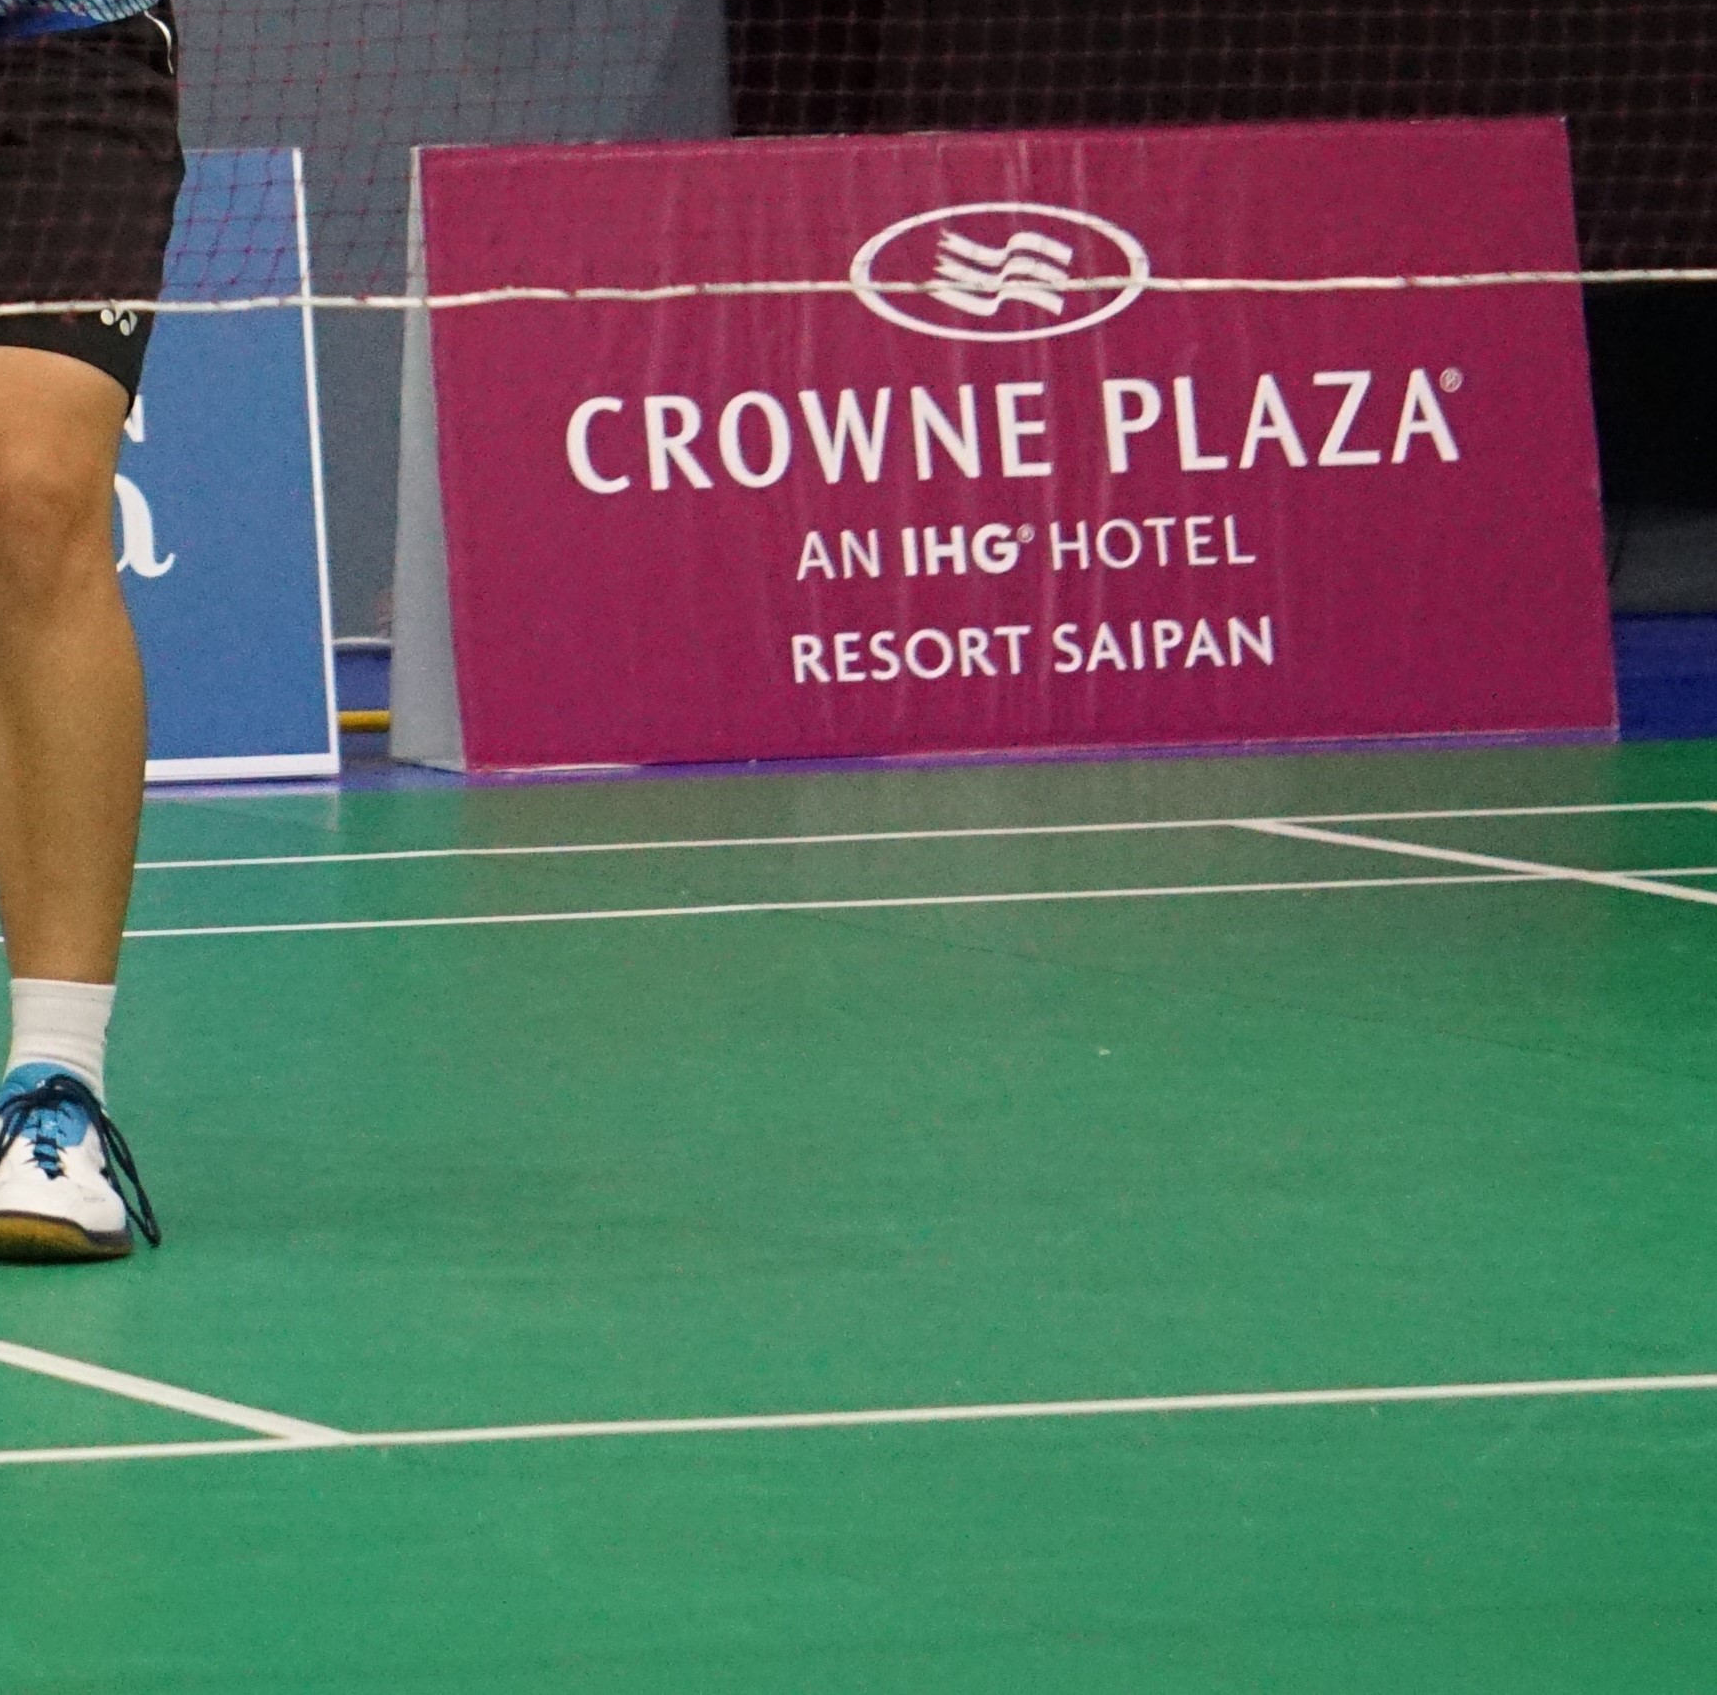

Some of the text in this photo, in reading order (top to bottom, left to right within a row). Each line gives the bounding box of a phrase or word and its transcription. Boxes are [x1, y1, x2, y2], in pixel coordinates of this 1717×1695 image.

[566, 381, 1053, 494] CROWNE
[796, 528, 880, 581] AN
[1049, 515, 1256, 571] HOTEL
[791, 616, 1273, 684] RESORT SAIPAN
